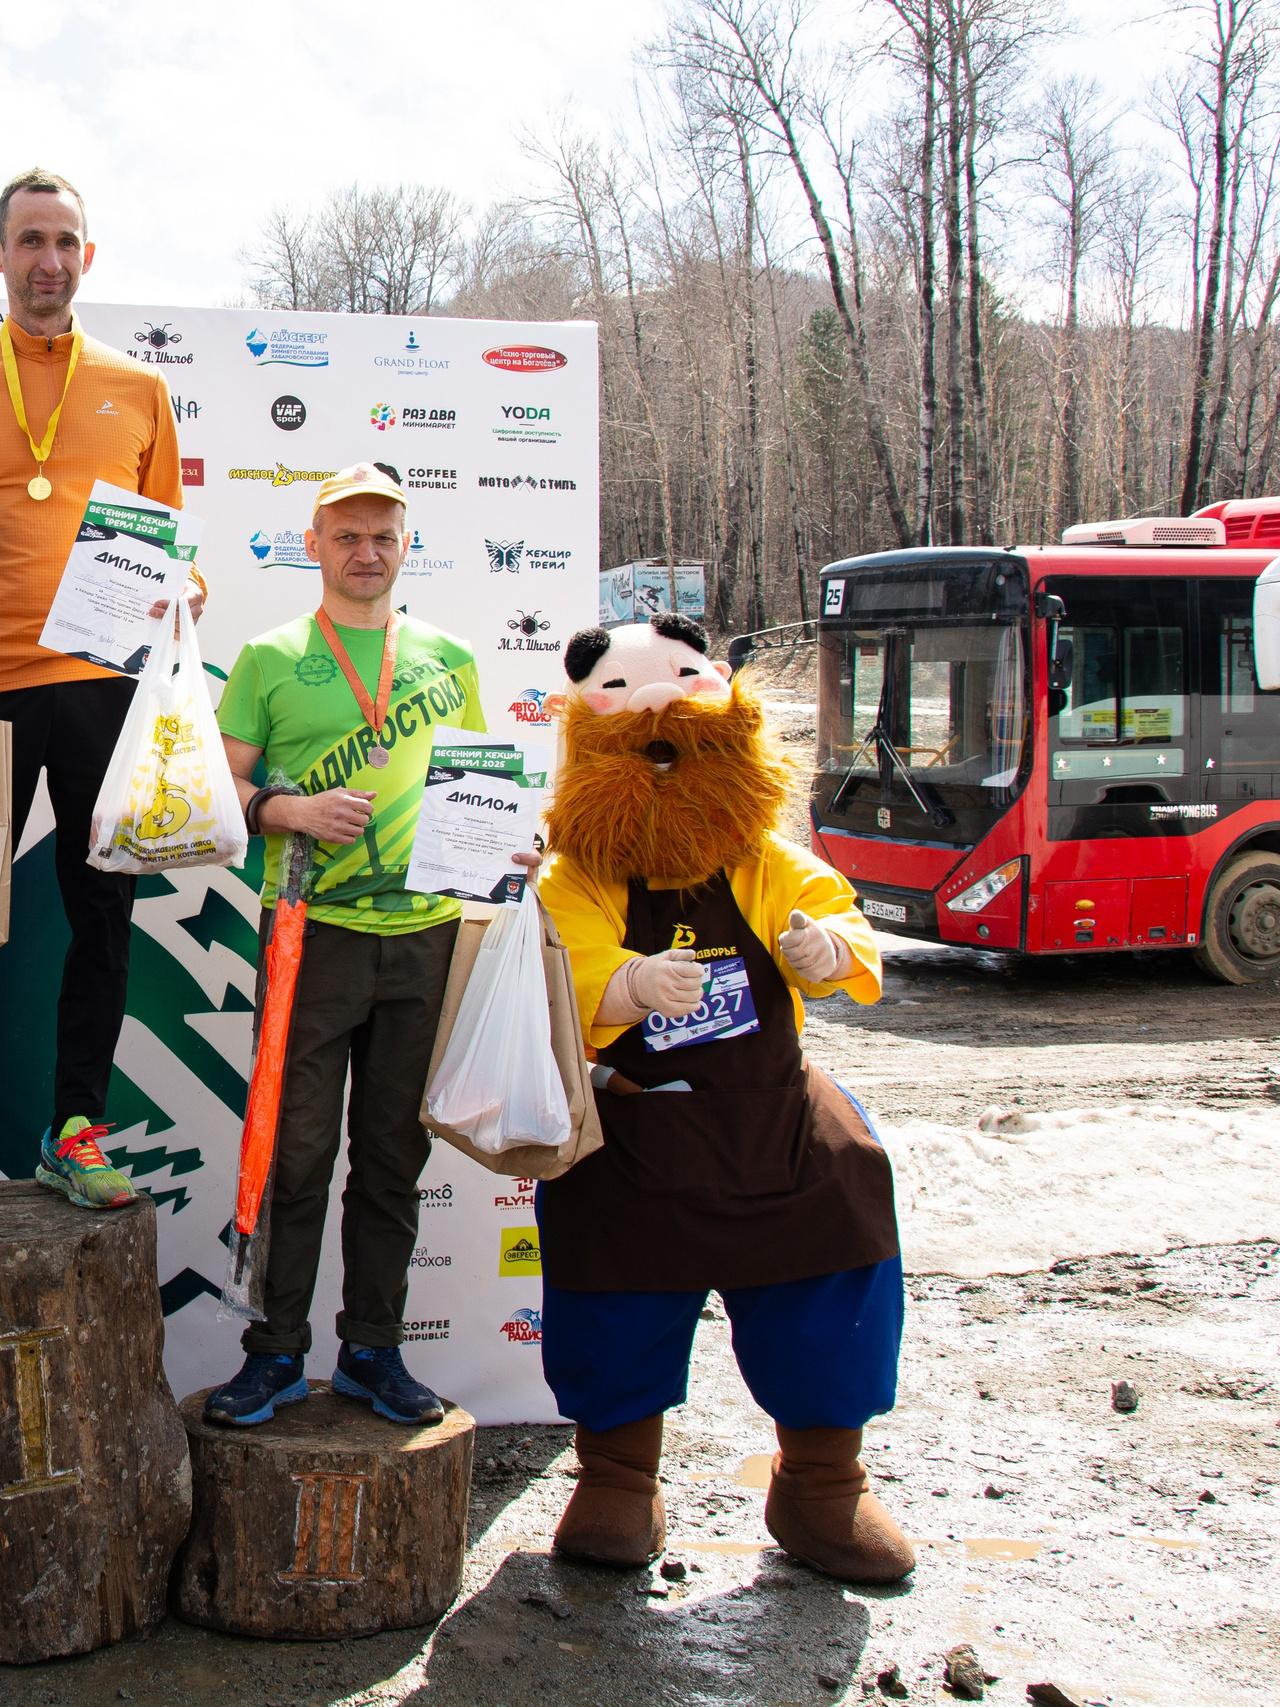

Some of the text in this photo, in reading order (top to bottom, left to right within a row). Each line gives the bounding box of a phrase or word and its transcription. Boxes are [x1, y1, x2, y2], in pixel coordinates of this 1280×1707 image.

[270, 329, 328, 344] АЙСБЕРГ
[490, 358, 511, 366] центр
[402, 408, 456, 421] РАЗ ДВА
[501, 405, 550, 420] YODA
[276, 416, 302, 424] sport
[402, 421, 456, 430] МИНИМАРКЕТ
[228, 468, 339, 482] МЯСНОЕ ПОДВОР
[408, 468, 457, 479] COFFEE
[408, 480, 457, 490] REPUBLIC
[478, 476, 510, 488] МОТО
[139, 515, 177, 529] ХЕХЦИР
[135, 523, 159, 535] 2025
[525, 549, 572, 558] ХЕХЦИР
[93, 551, 166, 584] ДИПЛОМ
[529, 561, 566, 569] ТРЕЙЛ
[826, 588, 841, 606] 25
[507, 702, 537, 712] АВТО
[516, 712, 552, 723] РАДИО
[298, 673, 466, 797] АДИВОСТОКА
[485, 751, 522, 760] ХЕХЦИР
[482, 760, 506, 768] 2025
[446, 791, 518, 814] ДИПЛОМ
[1200, 804, 1219, 817] BUS
[696, 946, 738, 959] ДВОРЬЕ
[494, 1195, 535, 1206] FLYH
[410, 1255, 452, 1267] РОХОВ
[507, 1251, 539, 1259] ЭВЕРЕСТ
[403, 1319, 450, 1331] COFFEE
[499, 1321, 530, 1333] АВТО
[403, 1331, 450, 1342] REPUBLIC
